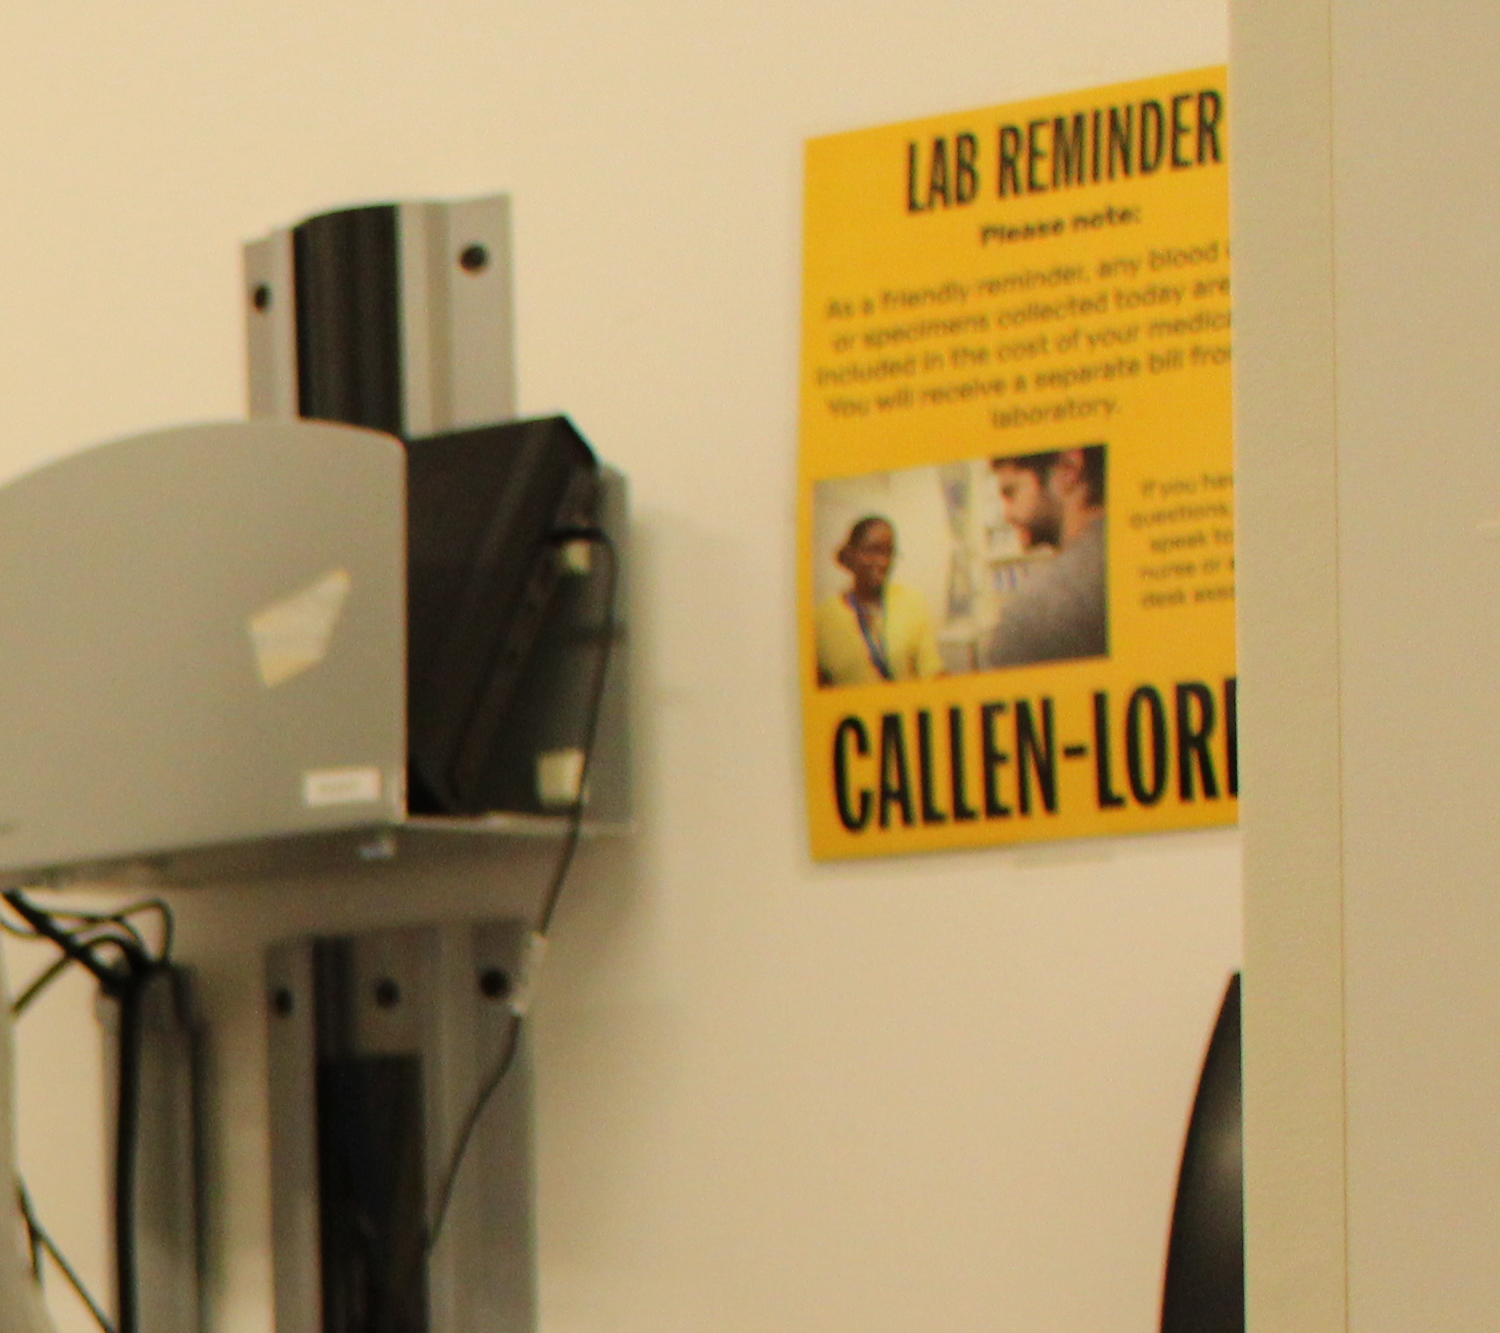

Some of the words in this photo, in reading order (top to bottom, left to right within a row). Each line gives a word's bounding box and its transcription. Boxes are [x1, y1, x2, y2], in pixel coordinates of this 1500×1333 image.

[906, 132, 981, 216] LAB
[997, 90, 1224, 201] REMINDER
[980, 218, 1065, 246] Please
[1072, 207, 1141, 231] note:
[880, 281, 968, 310] friendly
[1098, 258, 1142, 278] any
[1149, 240, 1218, 271] blood
[861, 313, 988, 349] specimens
[996, 291, 1108, 328] collected
[1113, 284, 1185, 311] today
[924, 351, 946, 370] in
[950, 346, 988, 367] the
[996, 334, 1047, 361] cost
[1056, 327, 1080, 351] of
[1087, 324, 1140, 350] your
[828, 398, 870, 418] You
[875, 388, 913, 411] will
[921, 377, 1007, 407] receive
[1034, 356, 1141, 389] separate
[1149, 347, 1185, 374] bill
